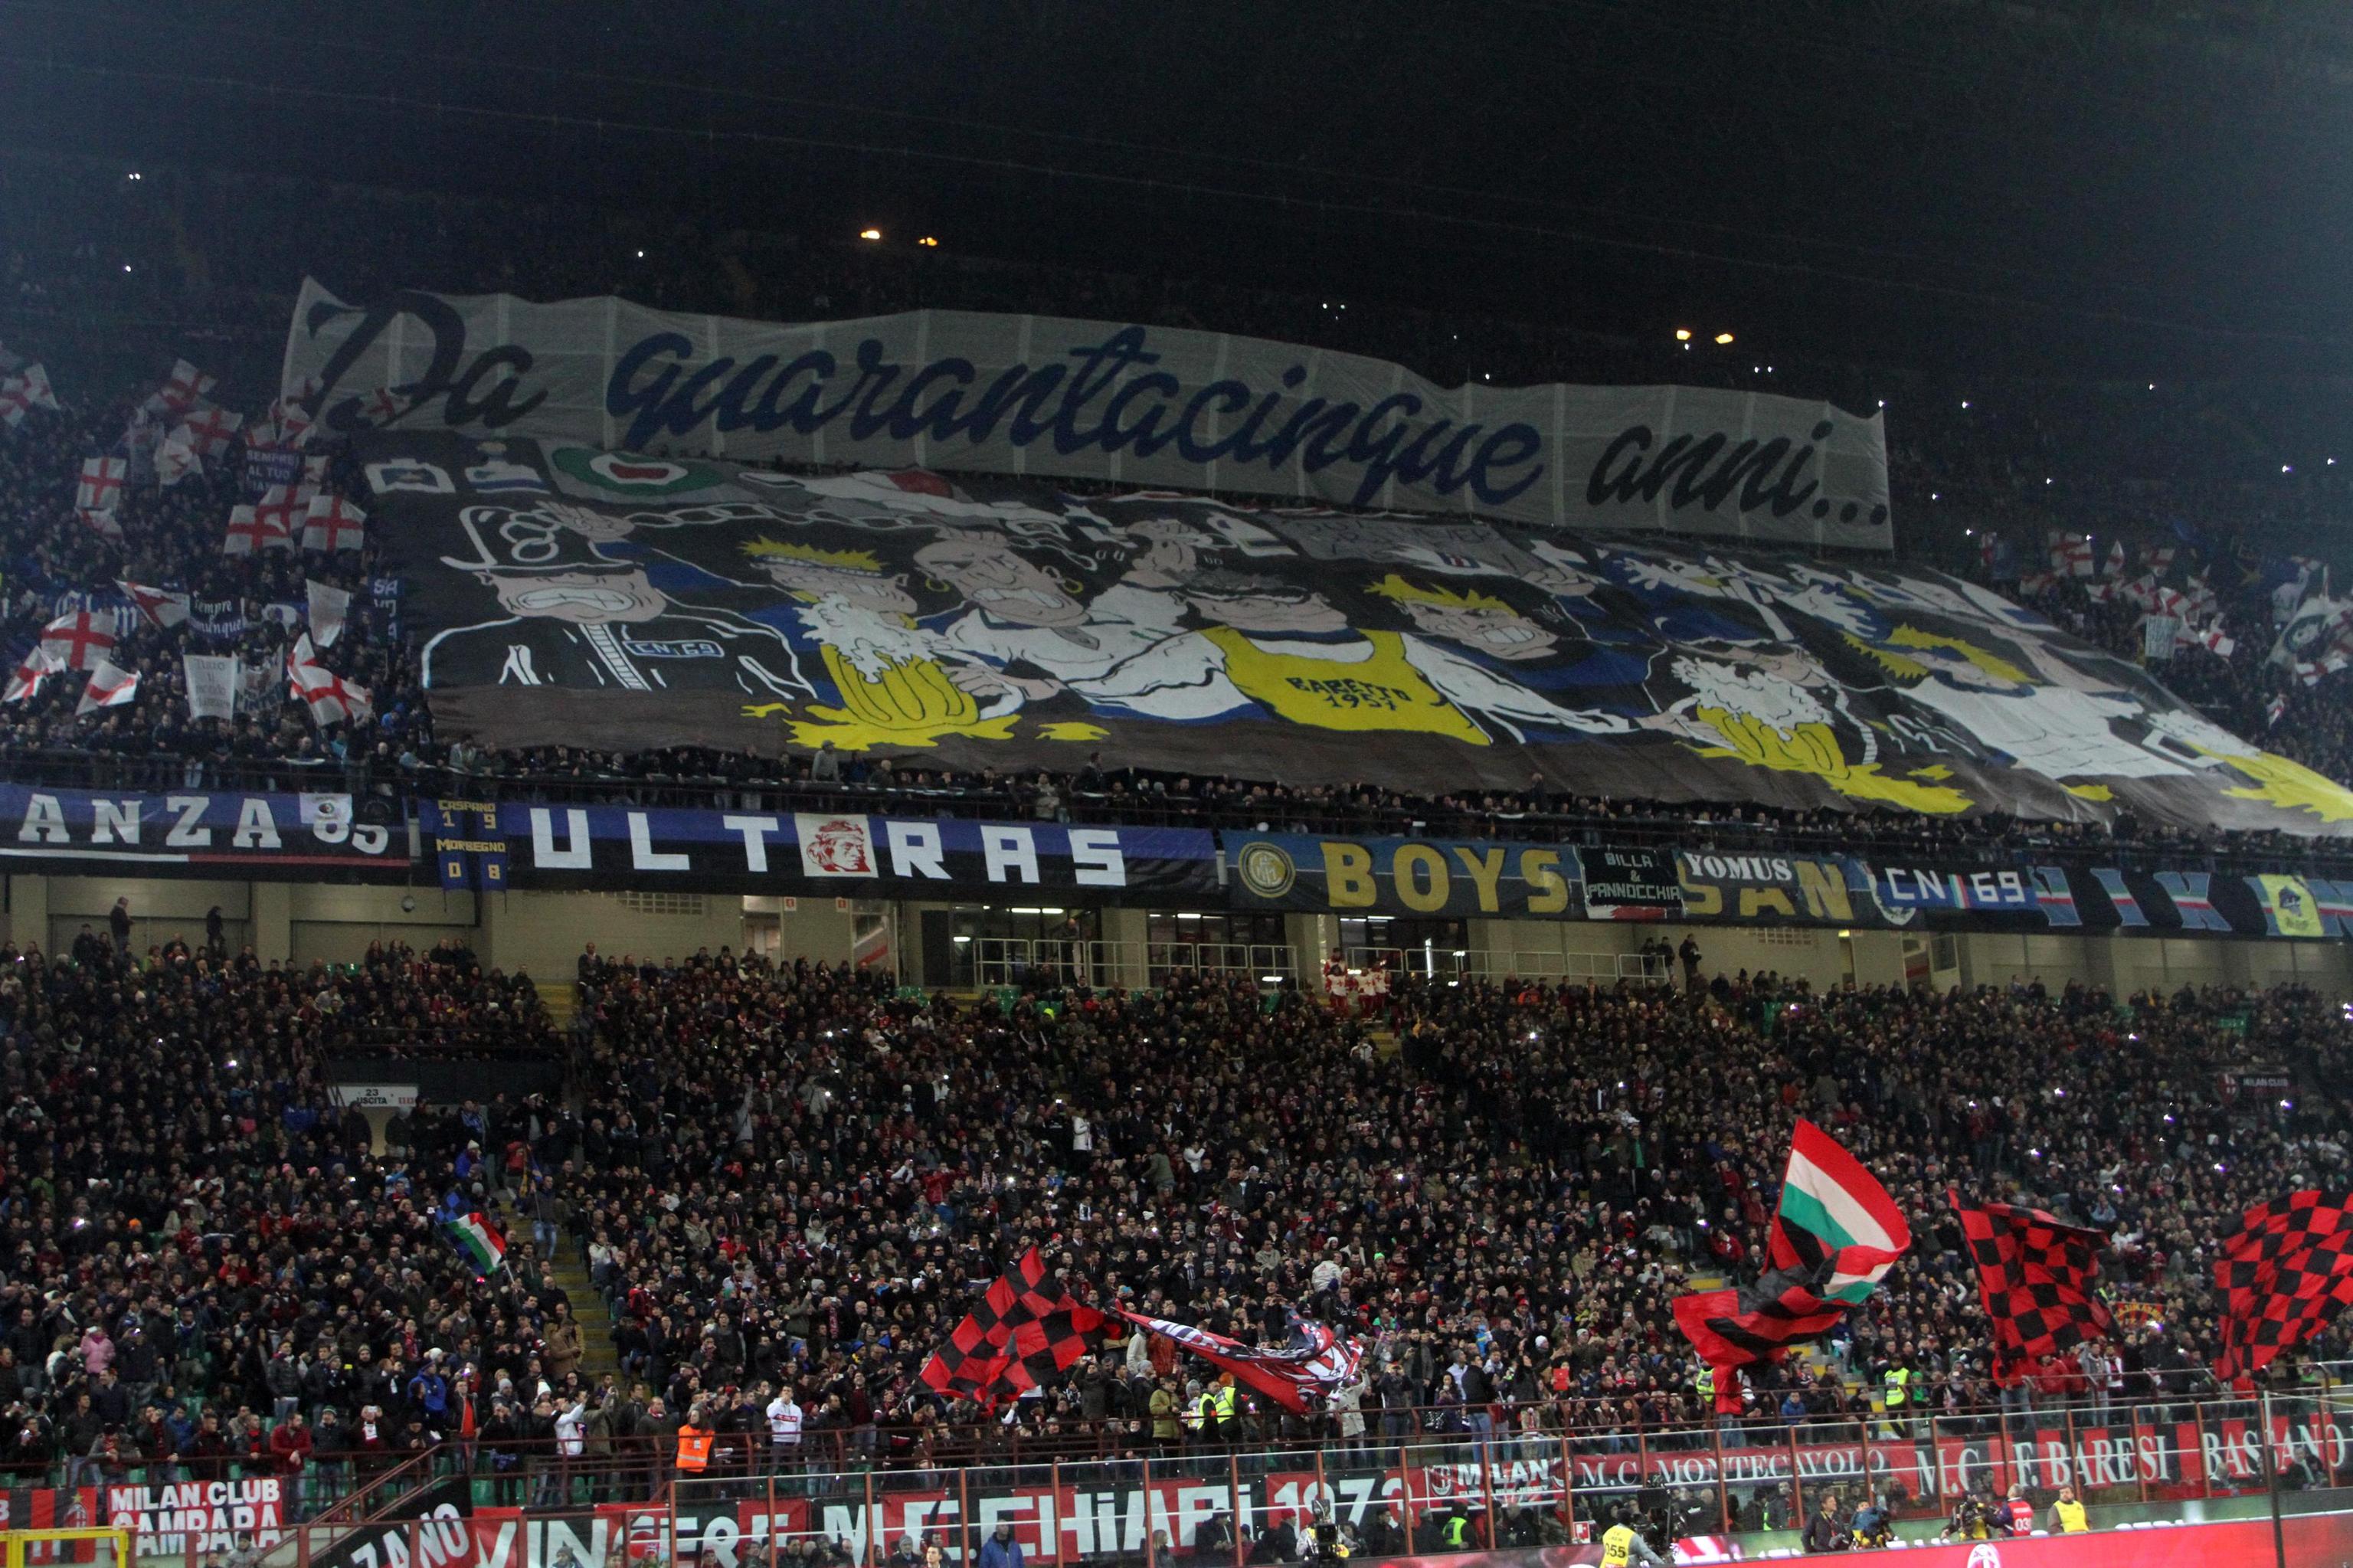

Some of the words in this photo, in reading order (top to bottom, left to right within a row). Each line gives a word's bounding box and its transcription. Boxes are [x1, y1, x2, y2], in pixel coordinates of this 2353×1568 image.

[306, 290, 548, 429] Da
[607, 325, 1543, 506] quarantacinque
[632, 640, 671, 656] CN
[687, 640, 718, 657] 69
[436, 838, 506, 853] MORBEGNO
[1605, 853, 1653, 869] BILLA
[1684, 852, 1792, 882] YOMUS
[1320, 841, 1569, 913] BOYS
[1885, 867, 1946, 900] CN
[1970, 871, 2025, 902] 69
[1587, 882, 1682, 901] PANNOCCHIA
[356, 1096, 388, 1105] USCITA
[1654, 1449, 1886, 1484] MONTECAVOLO
[2046, 1435, 2170, 1486] BARESI
[2202, 1423, 2346, 1481] BASANO
[1458, 1458, 1550, 1485] MLAN
